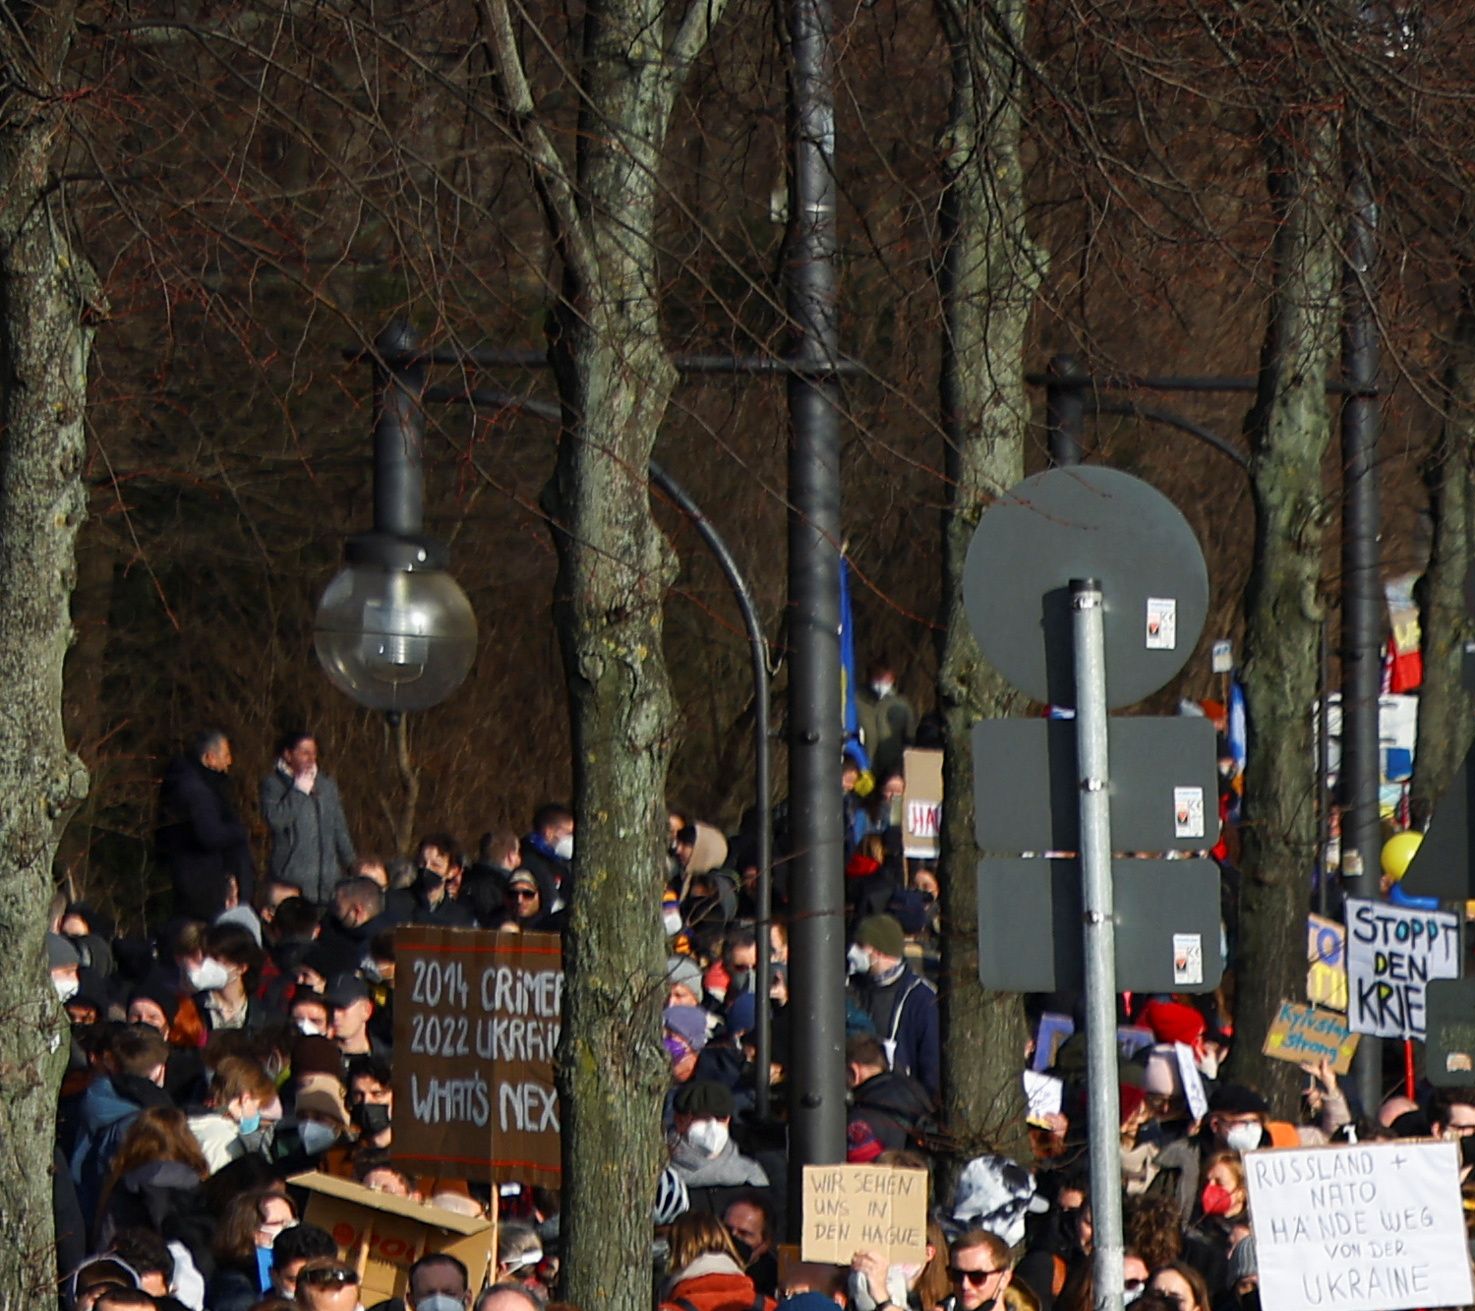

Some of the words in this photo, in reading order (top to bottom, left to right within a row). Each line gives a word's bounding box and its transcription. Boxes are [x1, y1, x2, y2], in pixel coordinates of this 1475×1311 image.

[1353, 906, 1459, 961] STOPPT
[1374, 950, 1428, 982] DEN
[411, 959, 470, 1010] 2014
[411, 1013, 470, 1057] 2022
[810, 1174, 844, 1195] WIR
[854, 1174, 914, 1196] SEHEN
[1255, 1150, 1375, 1190] RUSSLAND
[813, 1199, 850, 1218] UNS
[868, 1201, 888, 1219] IN
[1310, 1180, 1377, 1210] NATO
[1380, 1205, 1434, 1233] WEG
[813, 1223, 851, 1242] DEN
[861, 1225, 920, 1247] HAGUE
[1324, 1243, 1361, 1261] VON
[1302, 1263, 1430, 1306] UKRAINE
